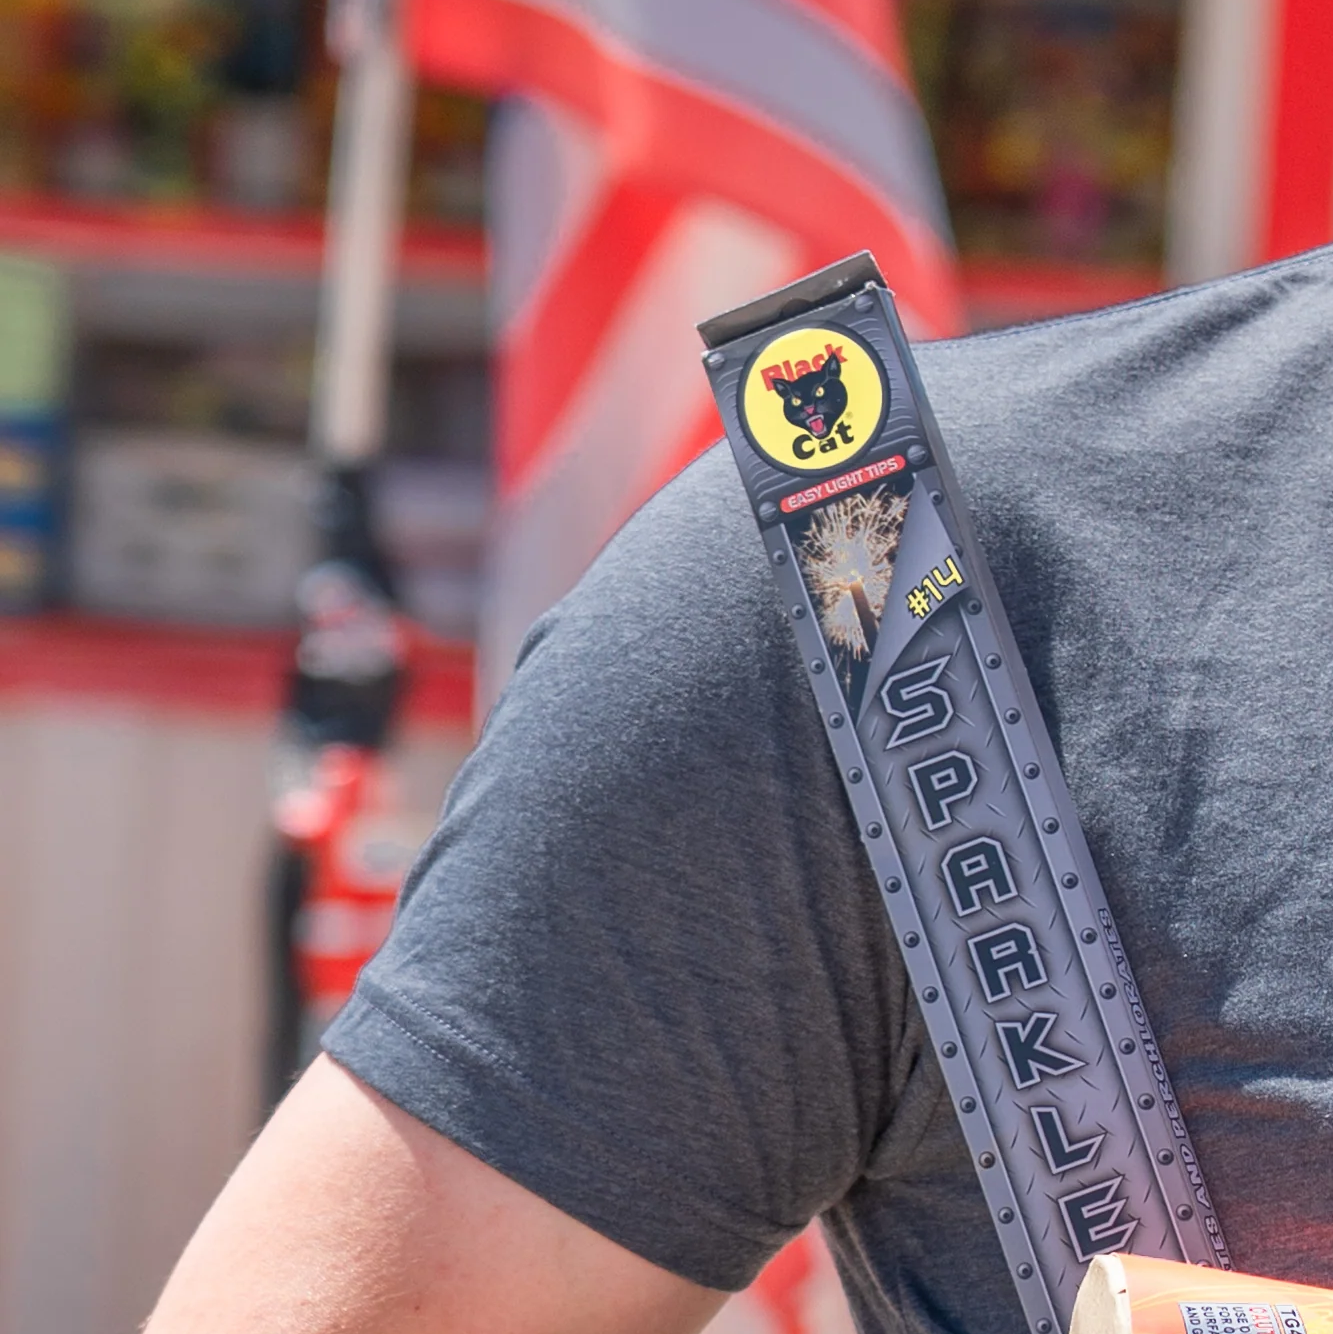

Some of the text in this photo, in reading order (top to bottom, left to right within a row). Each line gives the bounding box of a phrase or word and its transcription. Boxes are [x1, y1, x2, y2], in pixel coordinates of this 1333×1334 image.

[760, 343, 848, 391] Black
[792, 420, 854, 460] Cat
[787, 456, 899, 508] EASY LIGHT TIPS
[907, 556, 963, 619] #14
[1179, 1143, 1210, 1210] AND
[1185, 1304, 1200, 1325] AND
[1217, 1305, 1232, 1325] FOR
[1232, 1305, 1248, 1324] USE
